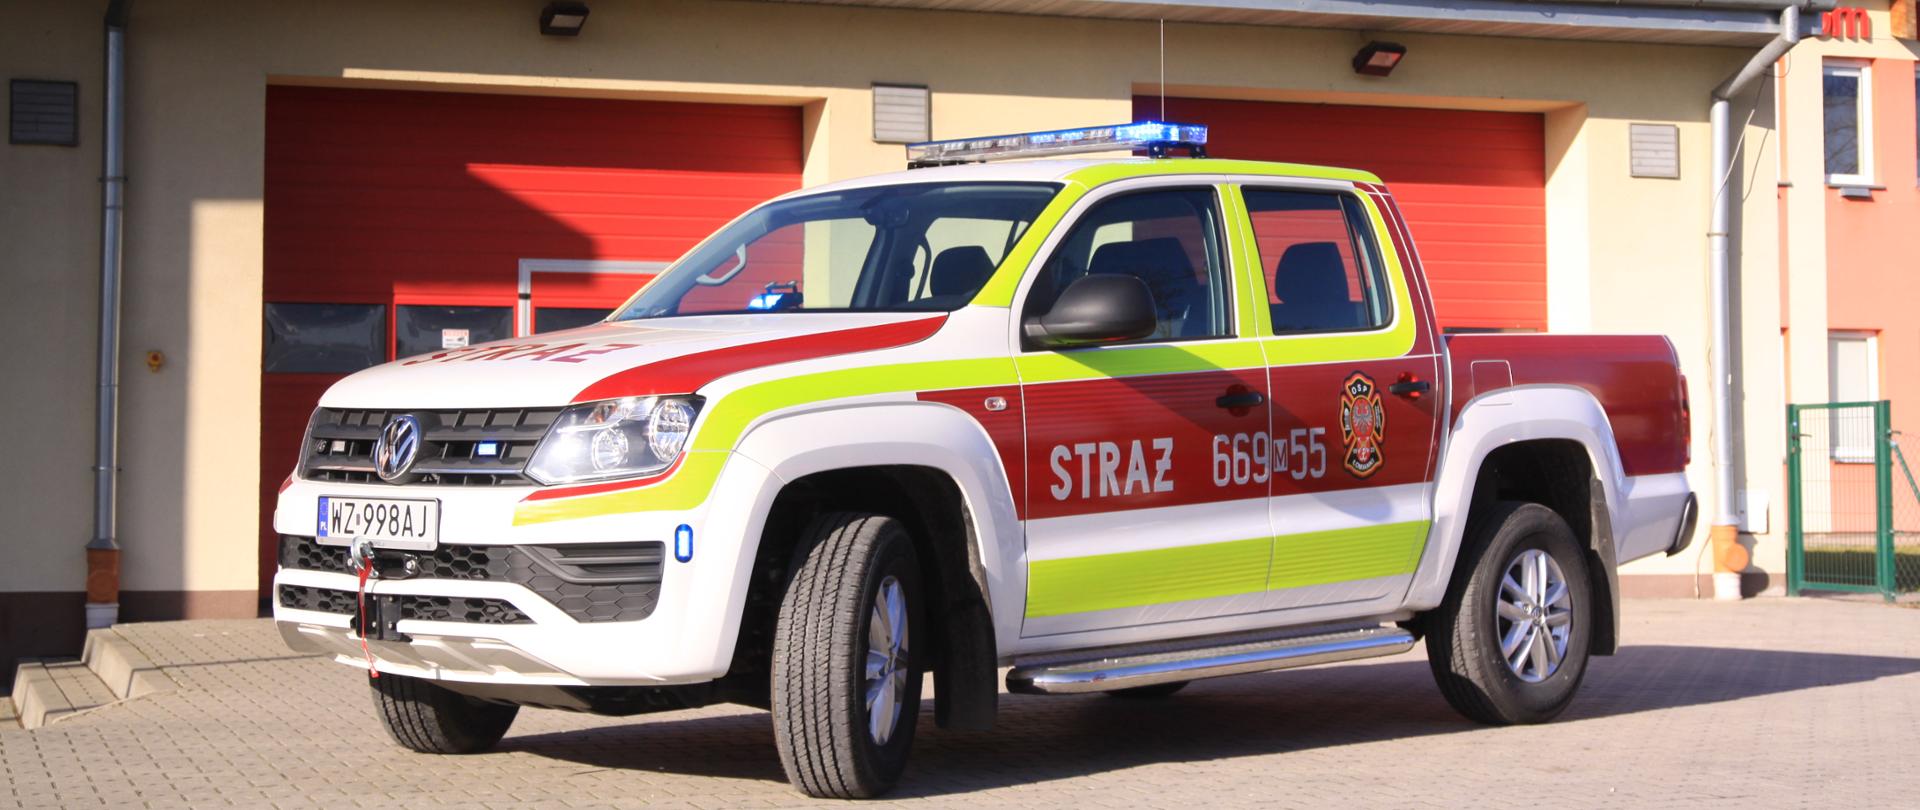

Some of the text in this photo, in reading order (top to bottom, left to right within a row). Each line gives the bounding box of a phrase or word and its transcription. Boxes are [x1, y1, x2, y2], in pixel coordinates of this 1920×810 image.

[1351, 383, 1368, 395] OSP
[1213, 427, 1326, 487] 669 M 55
[320, 521, 327, 531] PL
[332, 502, 427, 537] WZ 998AJ
